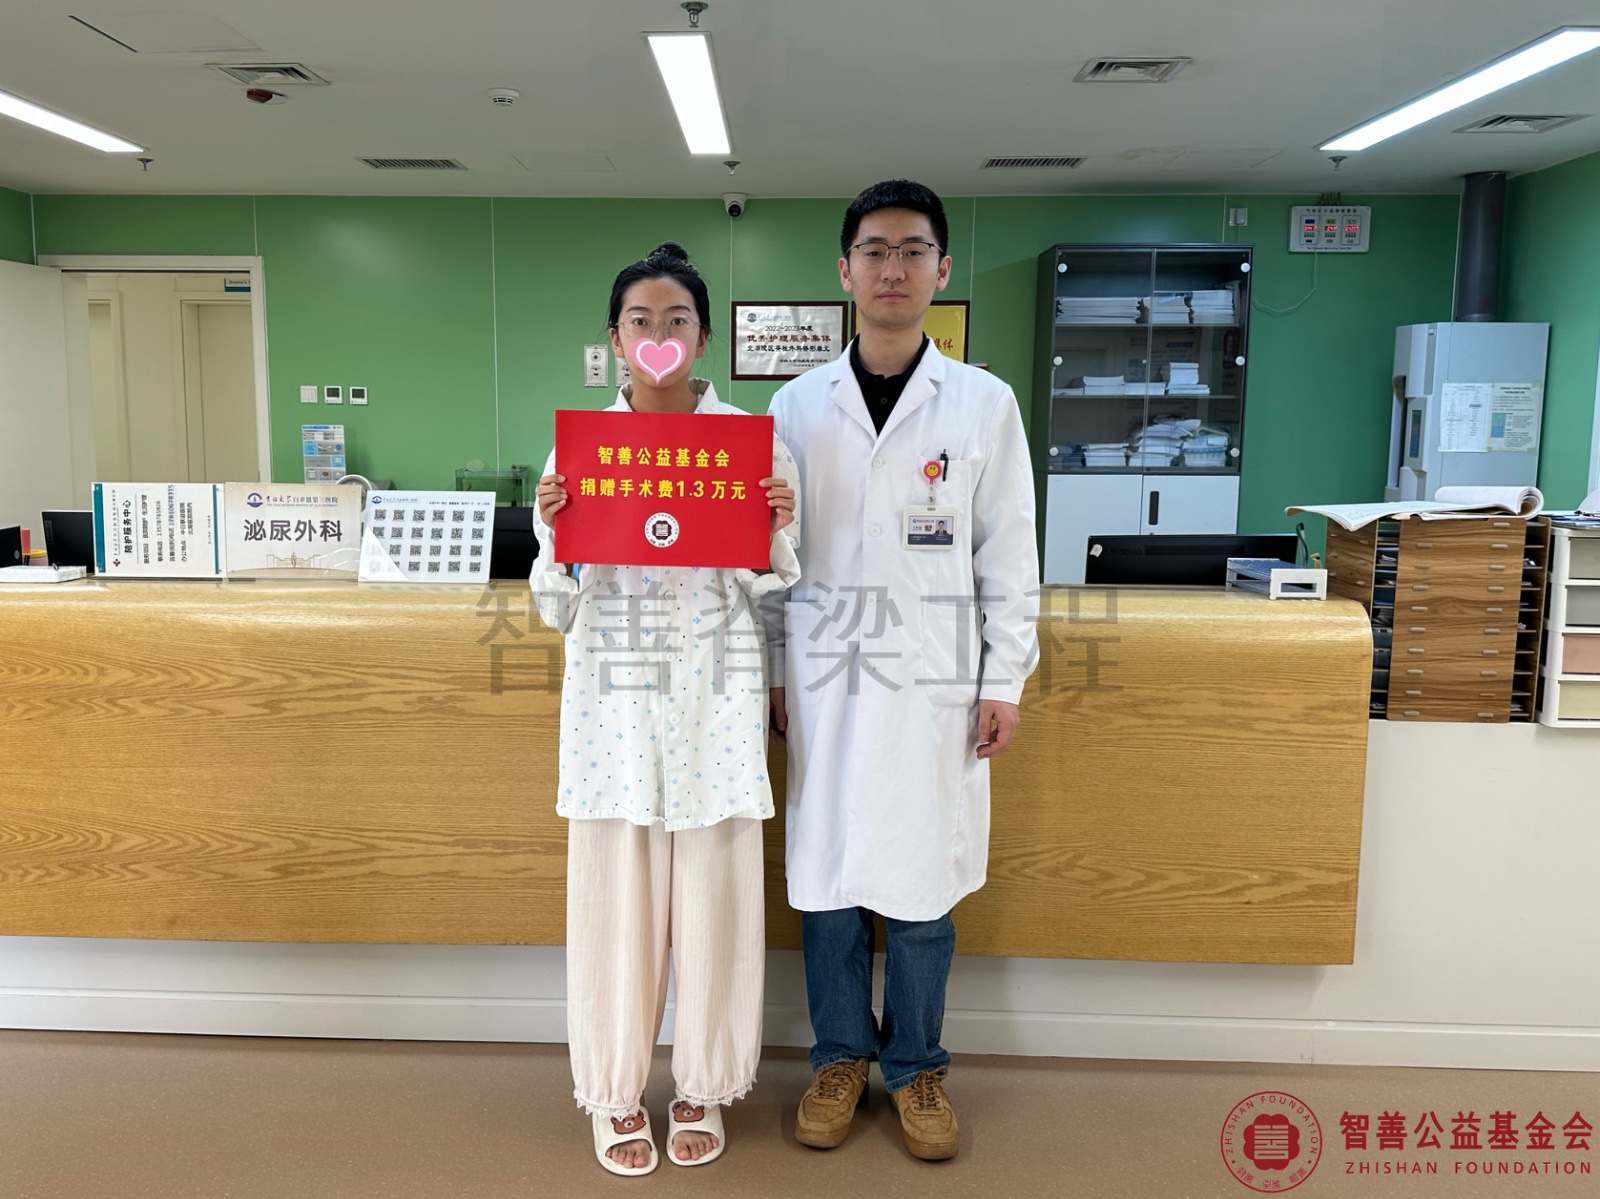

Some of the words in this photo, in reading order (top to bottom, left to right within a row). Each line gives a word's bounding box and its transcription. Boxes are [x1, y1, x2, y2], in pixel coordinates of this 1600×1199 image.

[597, 445, 730, 468] 智善公益基金会
[122, 499, 133, 554] 陪护服务中心
[244, 519, 342, 542] 泌尿外科
